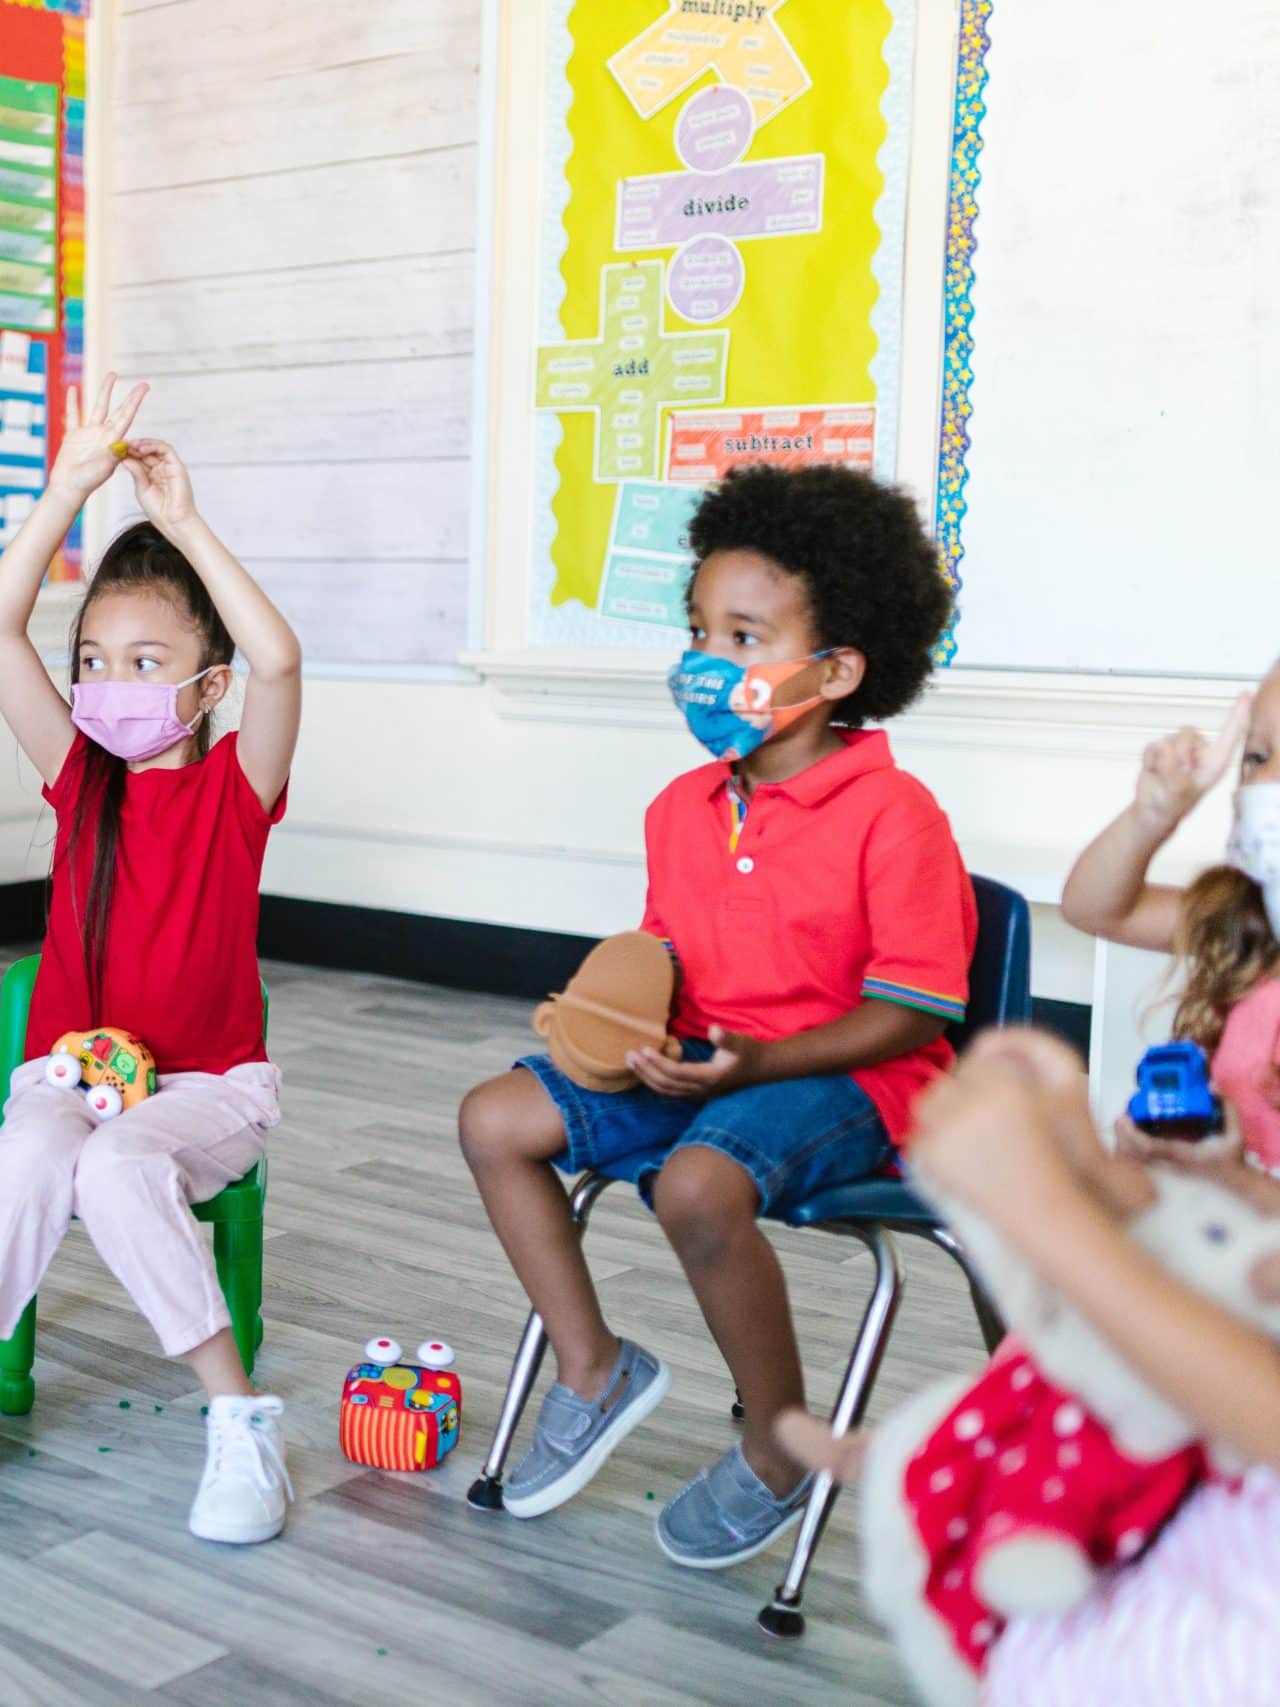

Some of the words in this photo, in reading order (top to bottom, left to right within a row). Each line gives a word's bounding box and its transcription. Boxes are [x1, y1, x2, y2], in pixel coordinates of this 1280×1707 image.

[680, 0, 766, 23] multiply
[682, 192, 750, 218] divide
[612, 356, 650, 377] add
[723, 432, 815, 453] subtract
